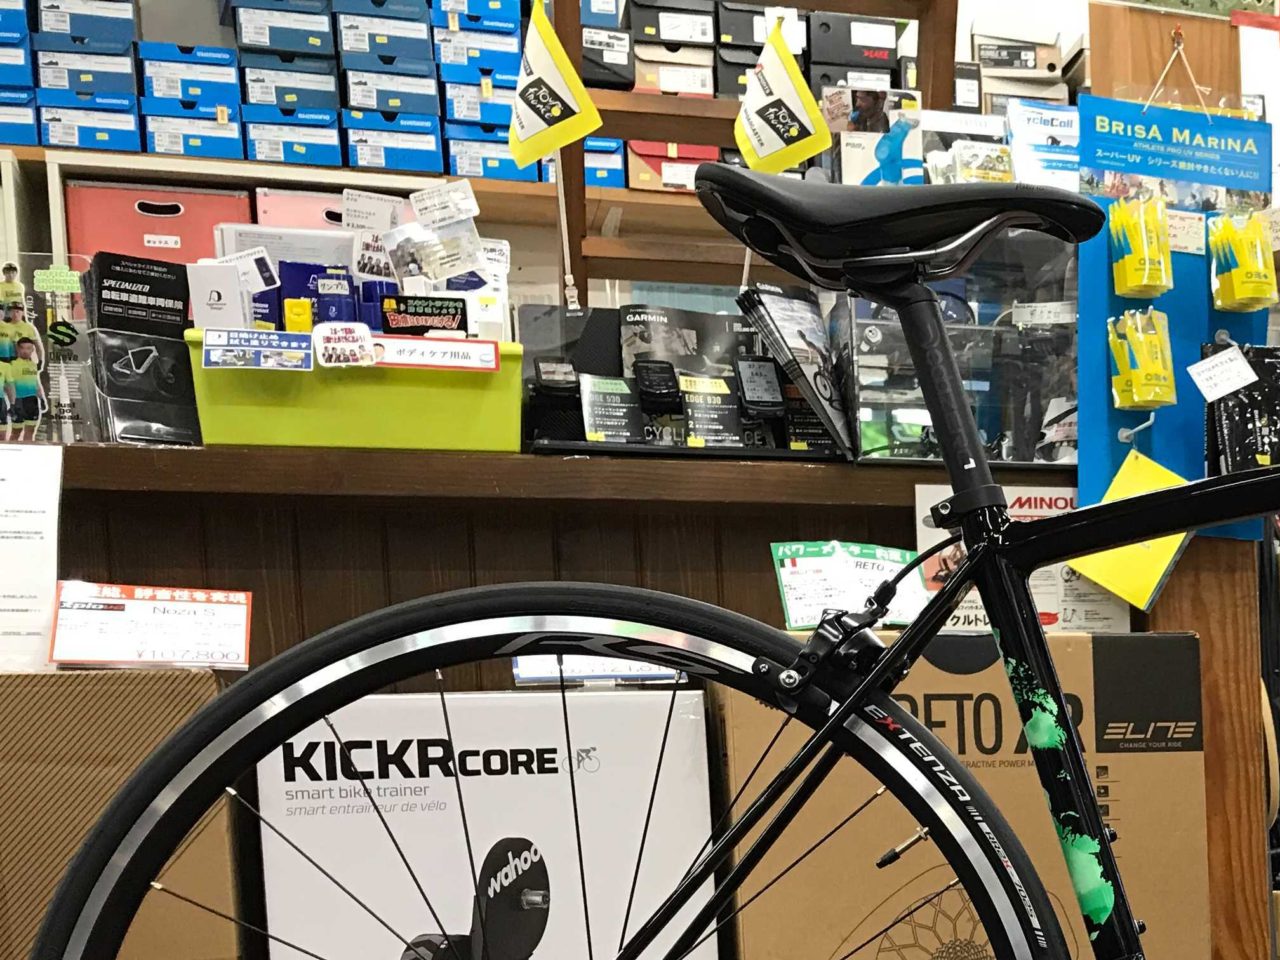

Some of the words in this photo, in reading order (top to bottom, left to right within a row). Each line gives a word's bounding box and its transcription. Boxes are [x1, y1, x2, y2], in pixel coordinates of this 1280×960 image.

[626, 314, 668, 323] GARMIN
[1009, 496, 1077, 510] MINOU
[1103, 721, 1197, 739] ELITE
[282, 738, 457, 783] KICKR
[457, 747, 559, 777] CORE
[864, 704, 970, 801] EXTENZA
[284, 786, 335, 801] smart
[338, 784, 371, 799] bike
[376, 783, 430, 798] trainer
[285, 804, 327, 817] smart
[401, 801, 419, 813] de
[420, 799, 447, 812] vélo
[487, 843, 542, 899] wahoo
